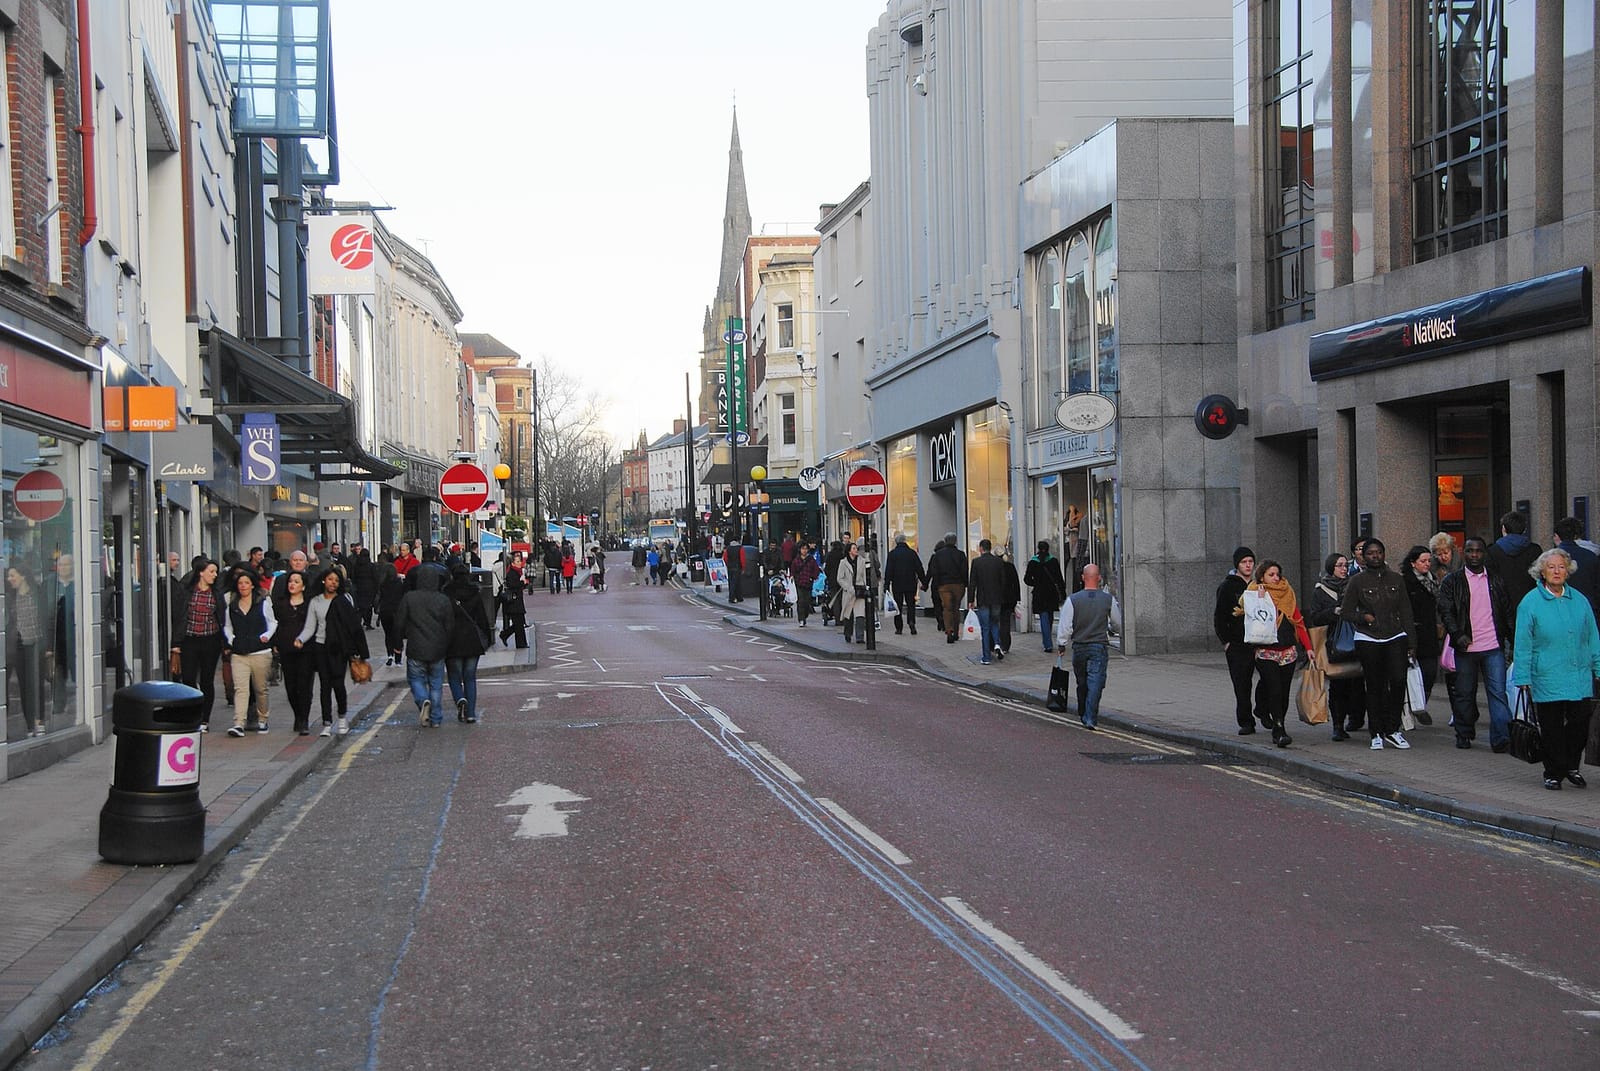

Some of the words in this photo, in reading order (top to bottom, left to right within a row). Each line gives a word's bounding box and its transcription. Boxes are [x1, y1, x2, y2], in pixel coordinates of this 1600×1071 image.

[1413, 314, 1457, 345] NatWest
[718, 373, 728, 424] BANK
[132, 418, 170, 430] orange
[247, 428, 274, 440] WH
[247, 440, 276, 482] S
[930, 427, 957, 482] next
[1049, 439, 1067, 456] LAURA
[1068, 435, 1089, 452] ASHLEY
[160, 462, 207, 477] Clarks
[167, 737, 196, 774] G
